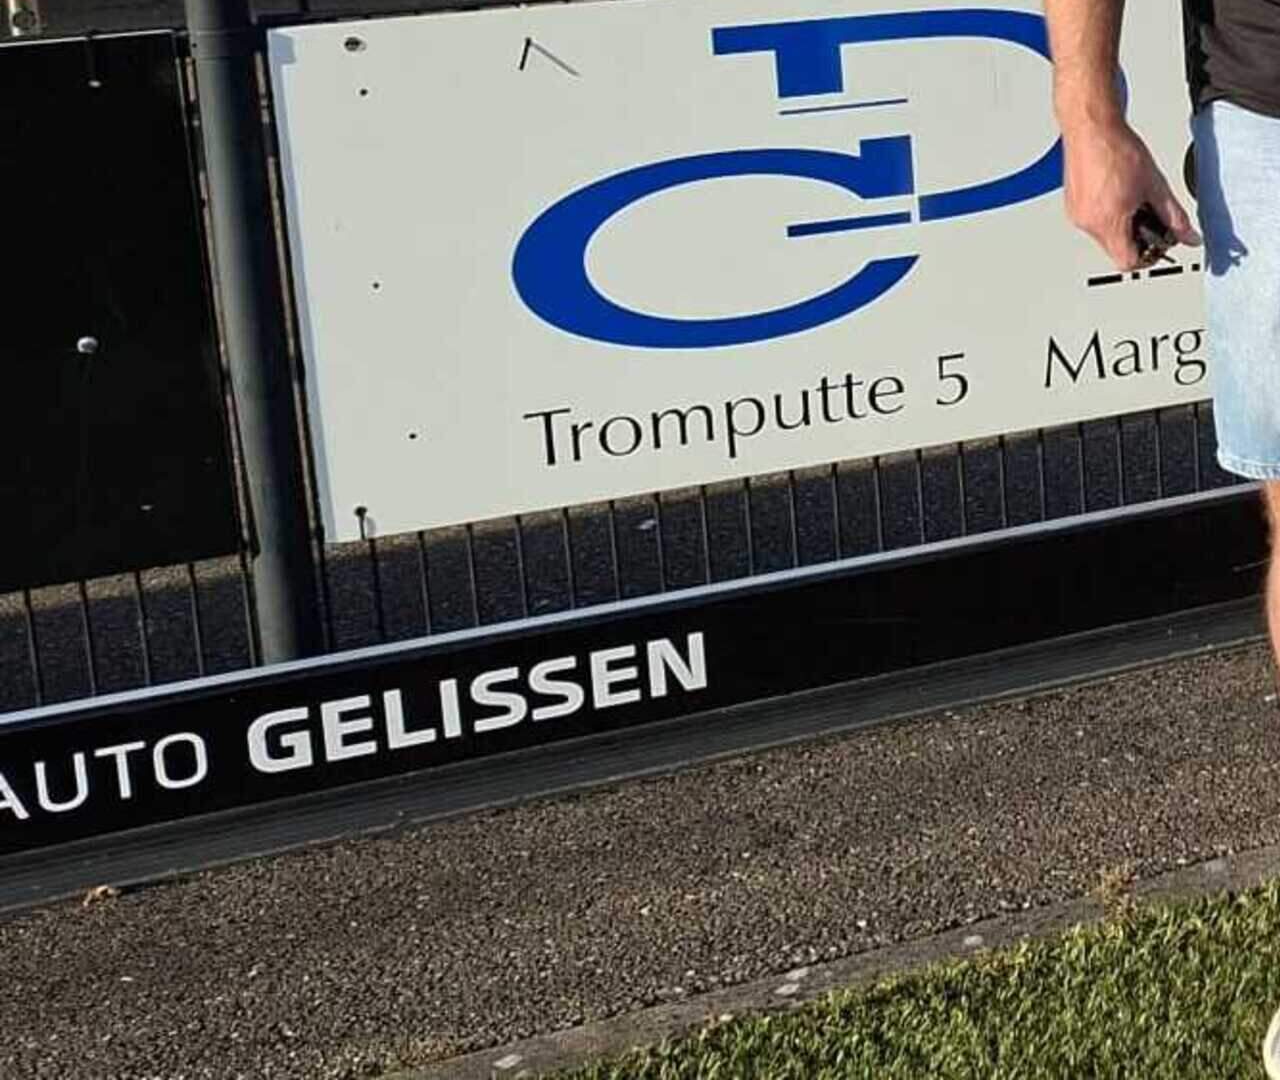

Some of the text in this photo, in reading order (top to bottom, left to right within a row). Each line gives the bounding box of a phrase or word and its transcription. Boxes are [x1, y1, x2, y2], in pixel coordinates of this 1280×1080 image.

[523, 372, 906, 466] Tromputte
[936, 353, 969, 407] 5
[247, 631, 708, 775] GELISSEN
